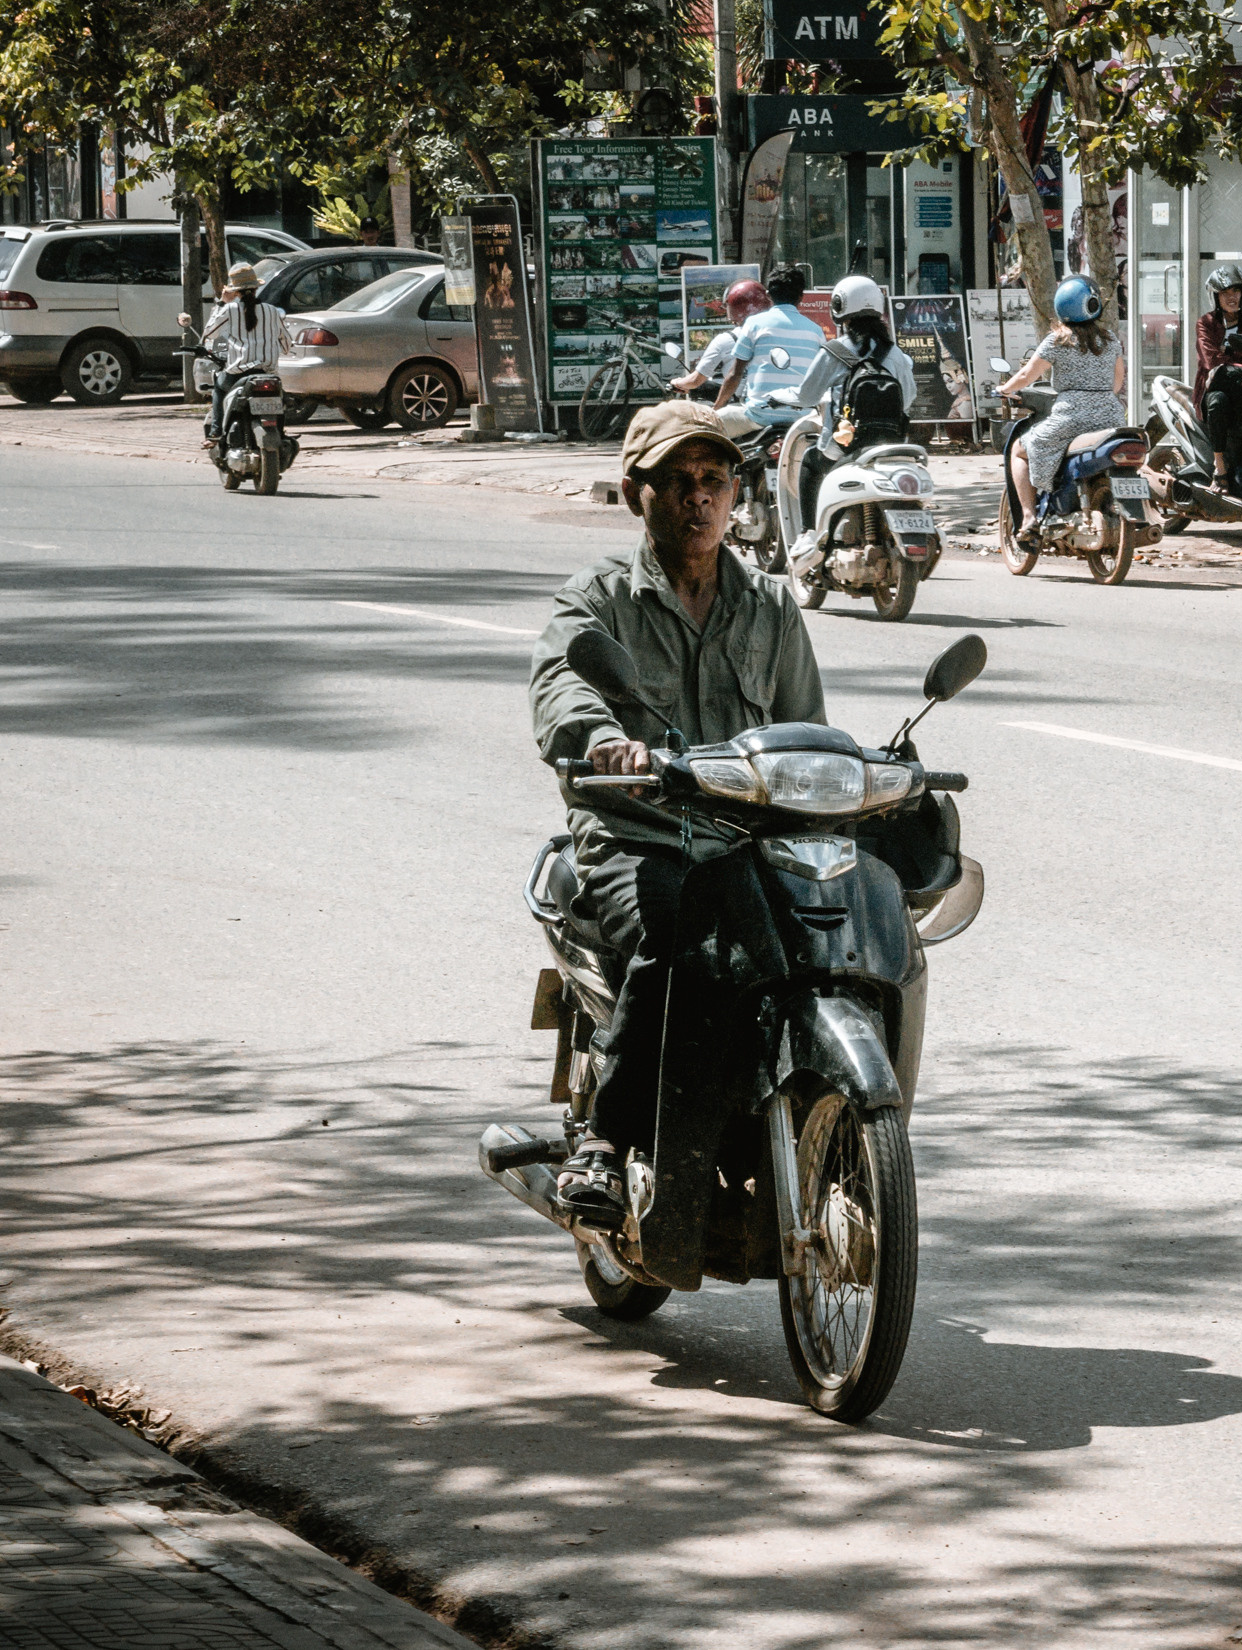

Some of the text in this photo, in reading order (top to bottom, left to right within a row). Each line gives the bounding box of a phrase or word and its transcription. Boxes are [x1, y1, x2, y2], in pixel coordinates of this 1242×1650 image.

[794, 15, 859, 40] ATM
[787, 108, 834, 125] ABA
[553, 144, 573, 154] Free
[574, 144, 596, 154] Tour
[597, 143, 648, 154] Information
[898, 337, 935, 348] SMILE
[1114, 485, 1148, 495] 1G-5454
[793, 837, 839, 847] HONDA
